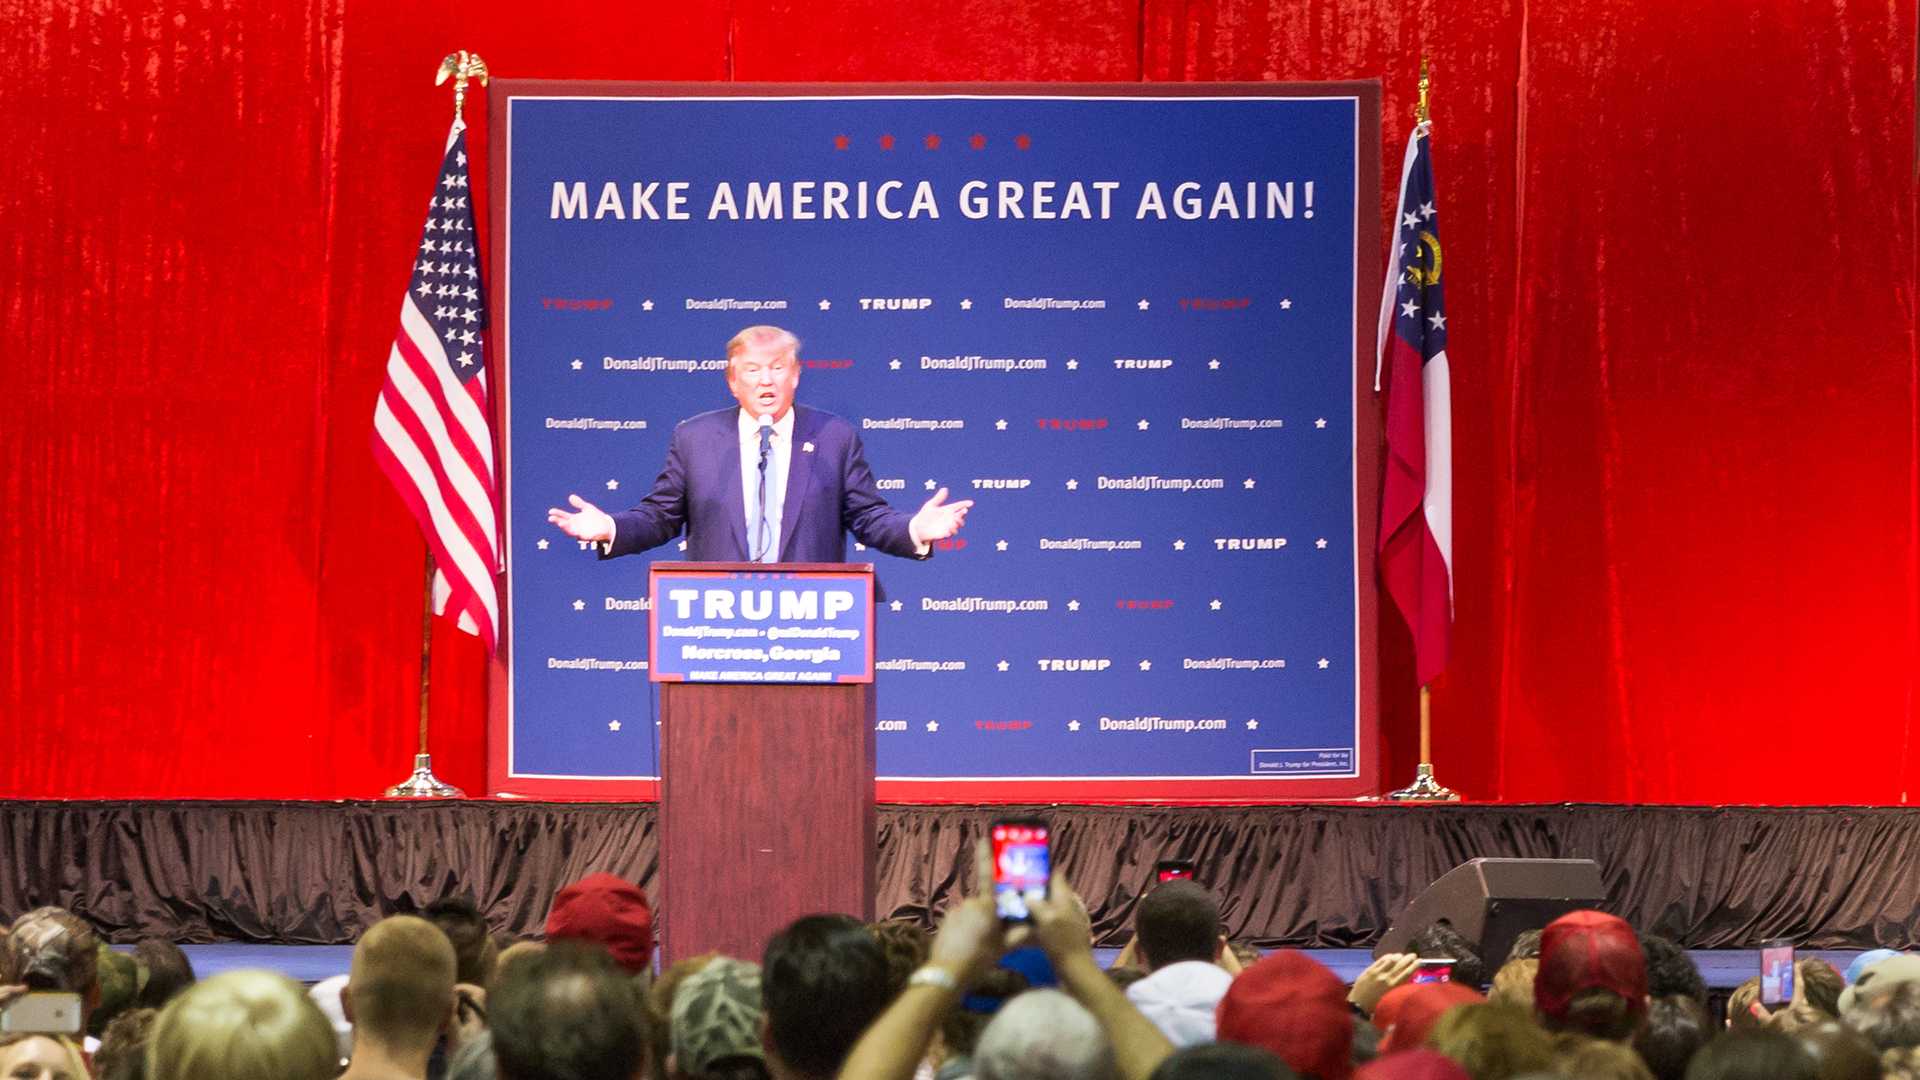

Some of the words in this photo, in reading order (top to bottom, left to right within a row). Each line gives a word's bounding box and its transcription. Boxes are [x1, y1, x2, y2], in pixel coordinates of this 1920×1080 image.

[551, 181, 691, 220] MAKE
[707, 180, 940, 220] AMERICA
[959, 180, 1120, 220] GREAT
[1135, 181, 1315, 220] AGAIN!
[685, 298, 788, 312] DonaldJTrump.com
[859, 298, 932, 310] TRUMP
[1004, 297, 1106, 311] DonaldJTrump.com
[603, 356, 729, 373] DonaldJTrump.com
[920, 356, 1047, 373] DonaldJTrump.com
[1113, 359, 1173, 369] TRUMP
[545, 417, 647, 432] DonaldJTrump.com
[862, 417, 964, 431] DonaldJTrump.com
[1181, 417, 1283, 431] DonaldJTrump.com
[971, 479, 1031, 489] TRUMP
[1097, 475, 1224, 493] DonaldJTrump.com
[1039, 538, 1142, 552] DonaldJTrump.com
[1213, 538, 1287, 550] TRUMP
[605, 597, 652, 611] Donald
[669, 588, 854, 621] TRUMP
[921, 597, 1049, 614] DonaldJTrump.com
[769, 646, 841, 664] Georgia
[547, 657, 649, 672] DonaldJTrump.com
[875, 658, 966, 673] naldJTrump.com
[1037, 659, 1111, 671] TRUMP
[1183, 657, 1286, 671] DonaldJTrump.com
[689, 671, 719, 681] MAKE
[720, 671, 763, 681] AMERICA
[764, 671, 797, 681] GREAT
[1099, 717, 1227, 733] DonaldJTrump.com
